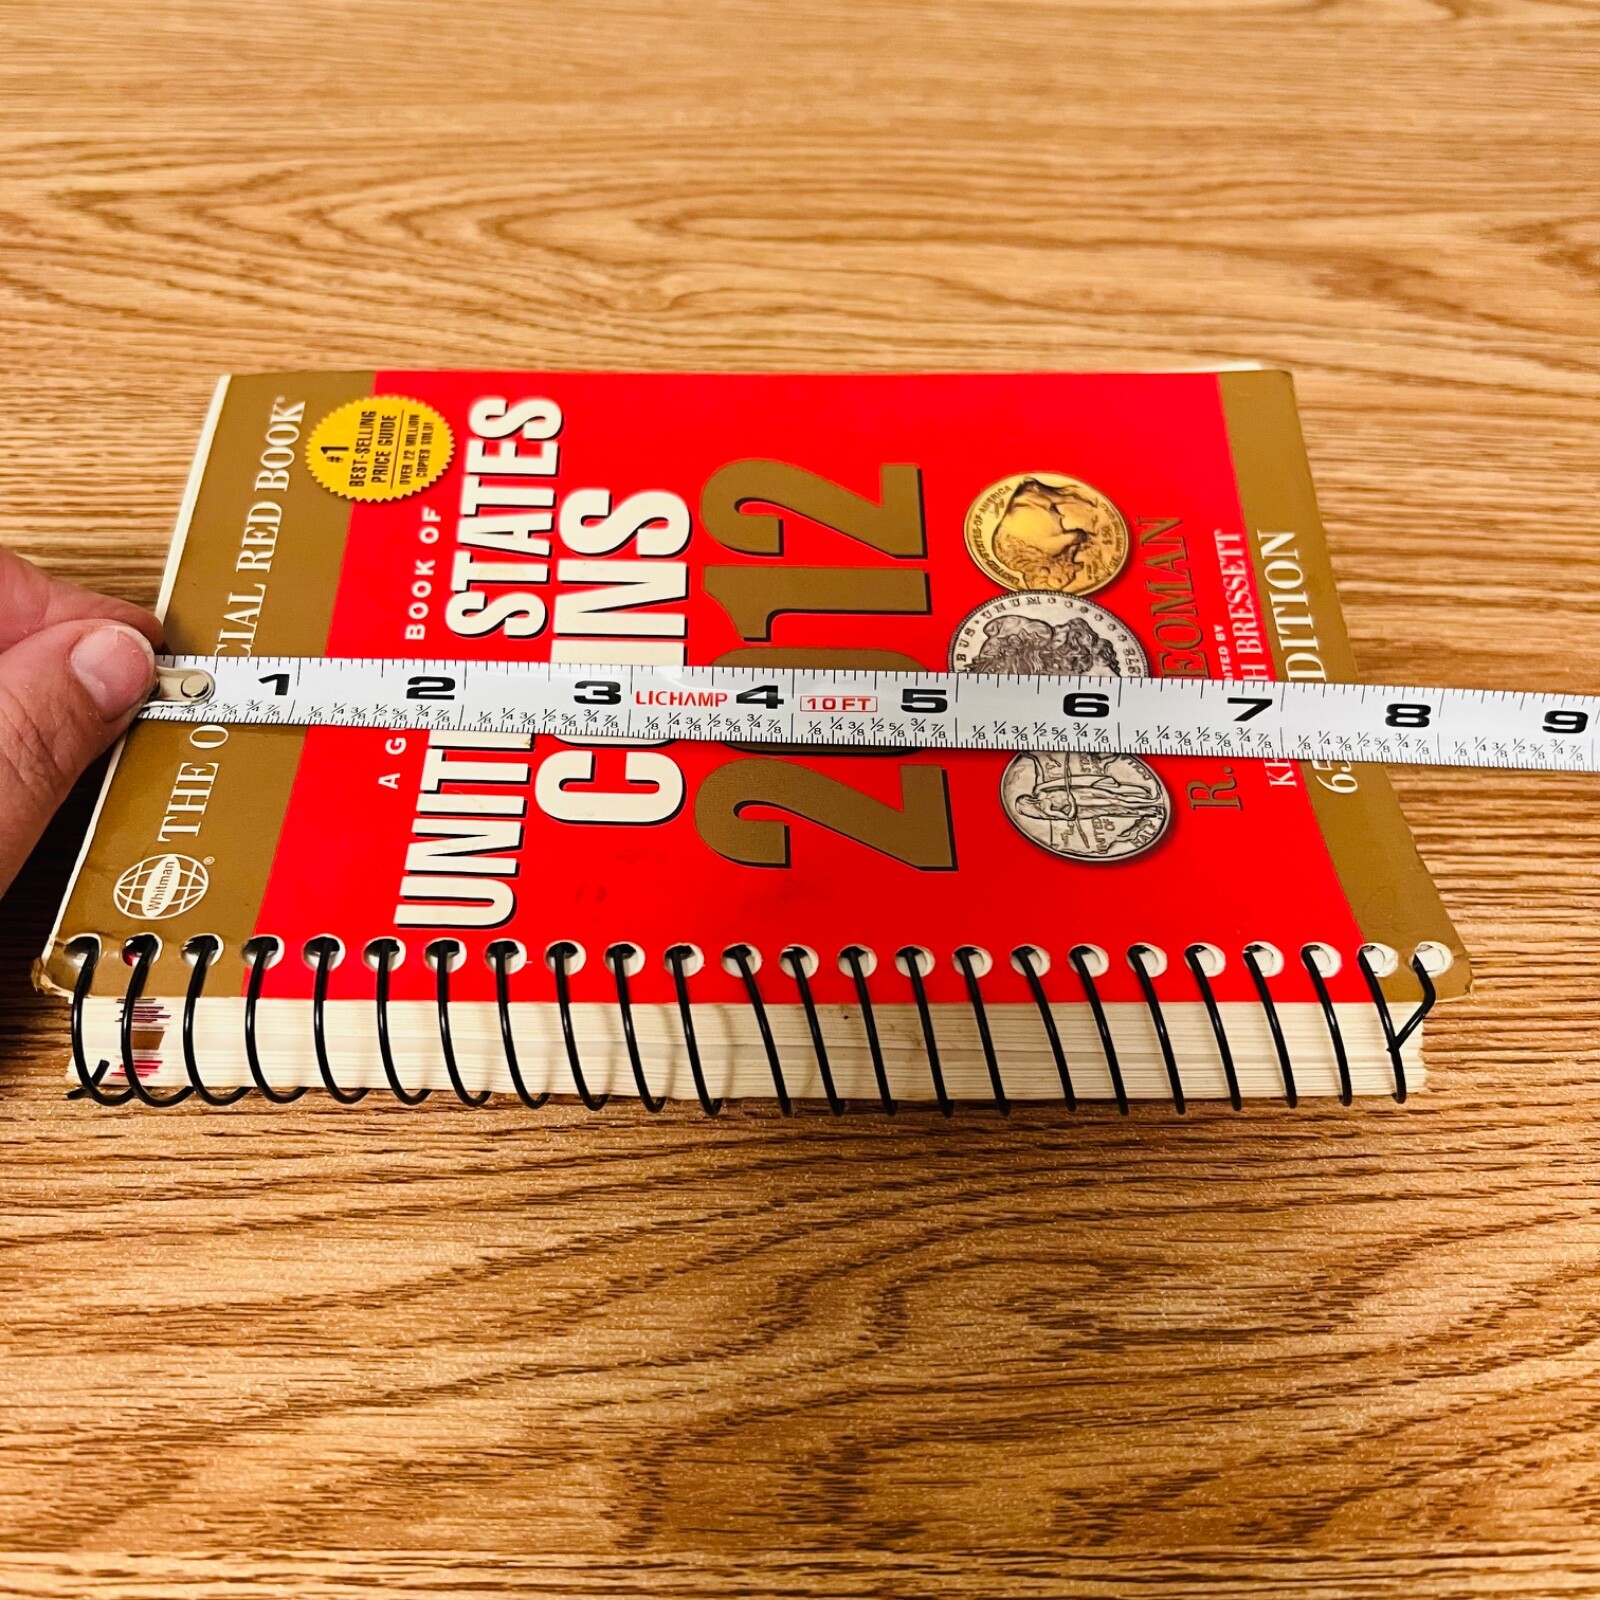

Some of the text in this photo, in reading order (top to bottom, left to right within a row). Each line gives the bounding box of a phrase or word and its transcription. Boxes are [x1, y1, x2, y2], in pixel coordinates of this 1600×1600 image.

[320, 446, 349, 463] #1
[348, 411, 377, 487] BEST-SELLING
[371, 415, 397, 483] PRICE GUIDE
[399, 414, 420, 485] OVER 22 MILLION
[416, 449, 431, 477] COPIES
[419, 508, 441, 544] OF
[405, 560, 435, 640] BOOK
[1214, 529, 1263, 654] BRESSETT
[1257, 529, 1327, 682] DITION
[393, 396, 563, 927] UNIT STATES
[535, 488, 693, 825] CINS
[1123, 648, 1143, 677] 878
[1136, 515, 1243, 811] R. EOMAN
[1213, 624, 1227, 641] BY
[157, 762, 219, 842] THE
[235, 501, 282, 574] RED
[258, 673, 290, 696] 1
[406, 676, 456, 700] 2
[573, 680, 622, 705] 3
[736, 685, 784, 710] 4
[901, 688, 948, 713] 5
[1063, 692, 1109, 718] 6
[1227, 697, 1273, 721] 7
[1385, 703, 1431, 728] 8
[1542, 710, 1589, 734] 9
[378, 773, 400, 789] A
[1103, 818, 1115, 831] OF
[147, 861, 175, 911] Whitman
